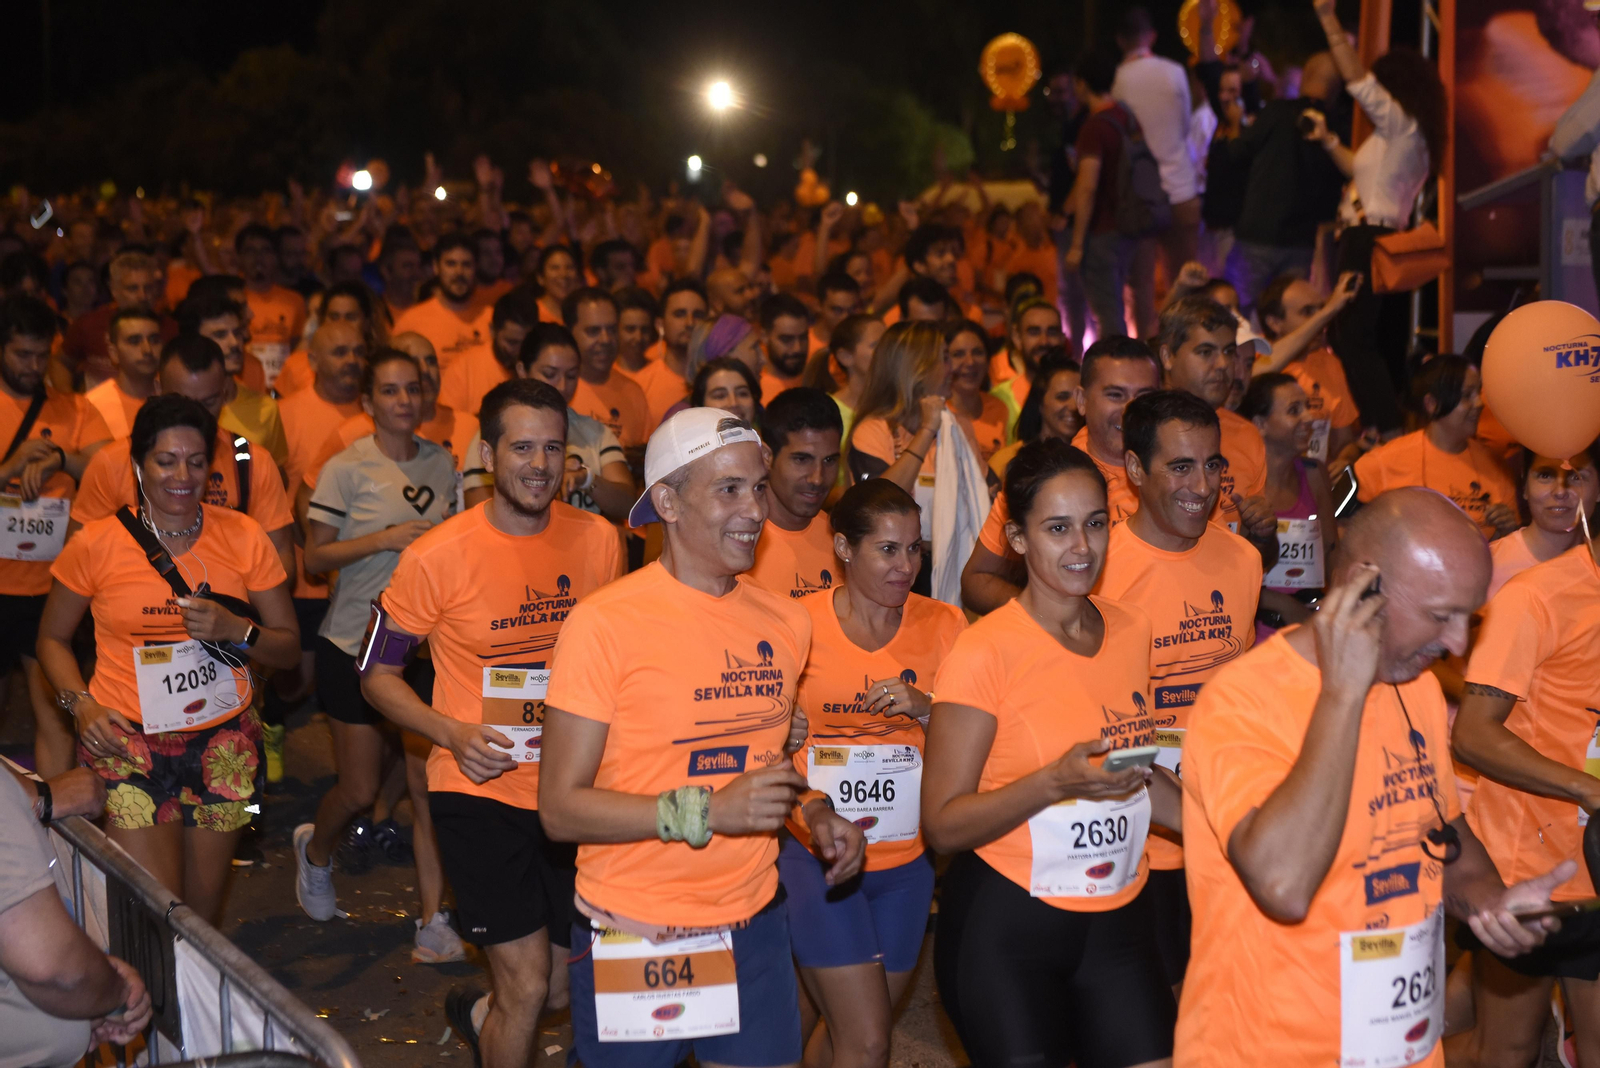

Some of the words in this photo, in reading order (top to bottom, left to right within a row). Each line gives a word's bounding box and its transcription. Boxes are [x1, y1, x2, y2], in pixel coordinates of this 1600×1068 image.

[1543, 341, 1589, 353] NOCTURNA
[7, 516, 55, 536] 21508
[1280, 542, 1314, 560] 2511
[142, 606, 181, 615] SEVILL
[519, 597, 578, 614] NOCTURNA
[490, 613, 548, 631] SEVILLA
[550, 610, 570, 623] KH
[1179, 614, 1232, 631] NOCTURNA
[1154, 631, 1206, 649] SEVILLA
[162, 661, 217, 695] 12038
[721, 669, 783, 683] NOCTURNA
[694, 685, 753, 702] SEVILLA
[839, 779, 896, 804] 9646
[1070, 815, 1128, 849] 2630
[644, 957, 695, 989] 664
